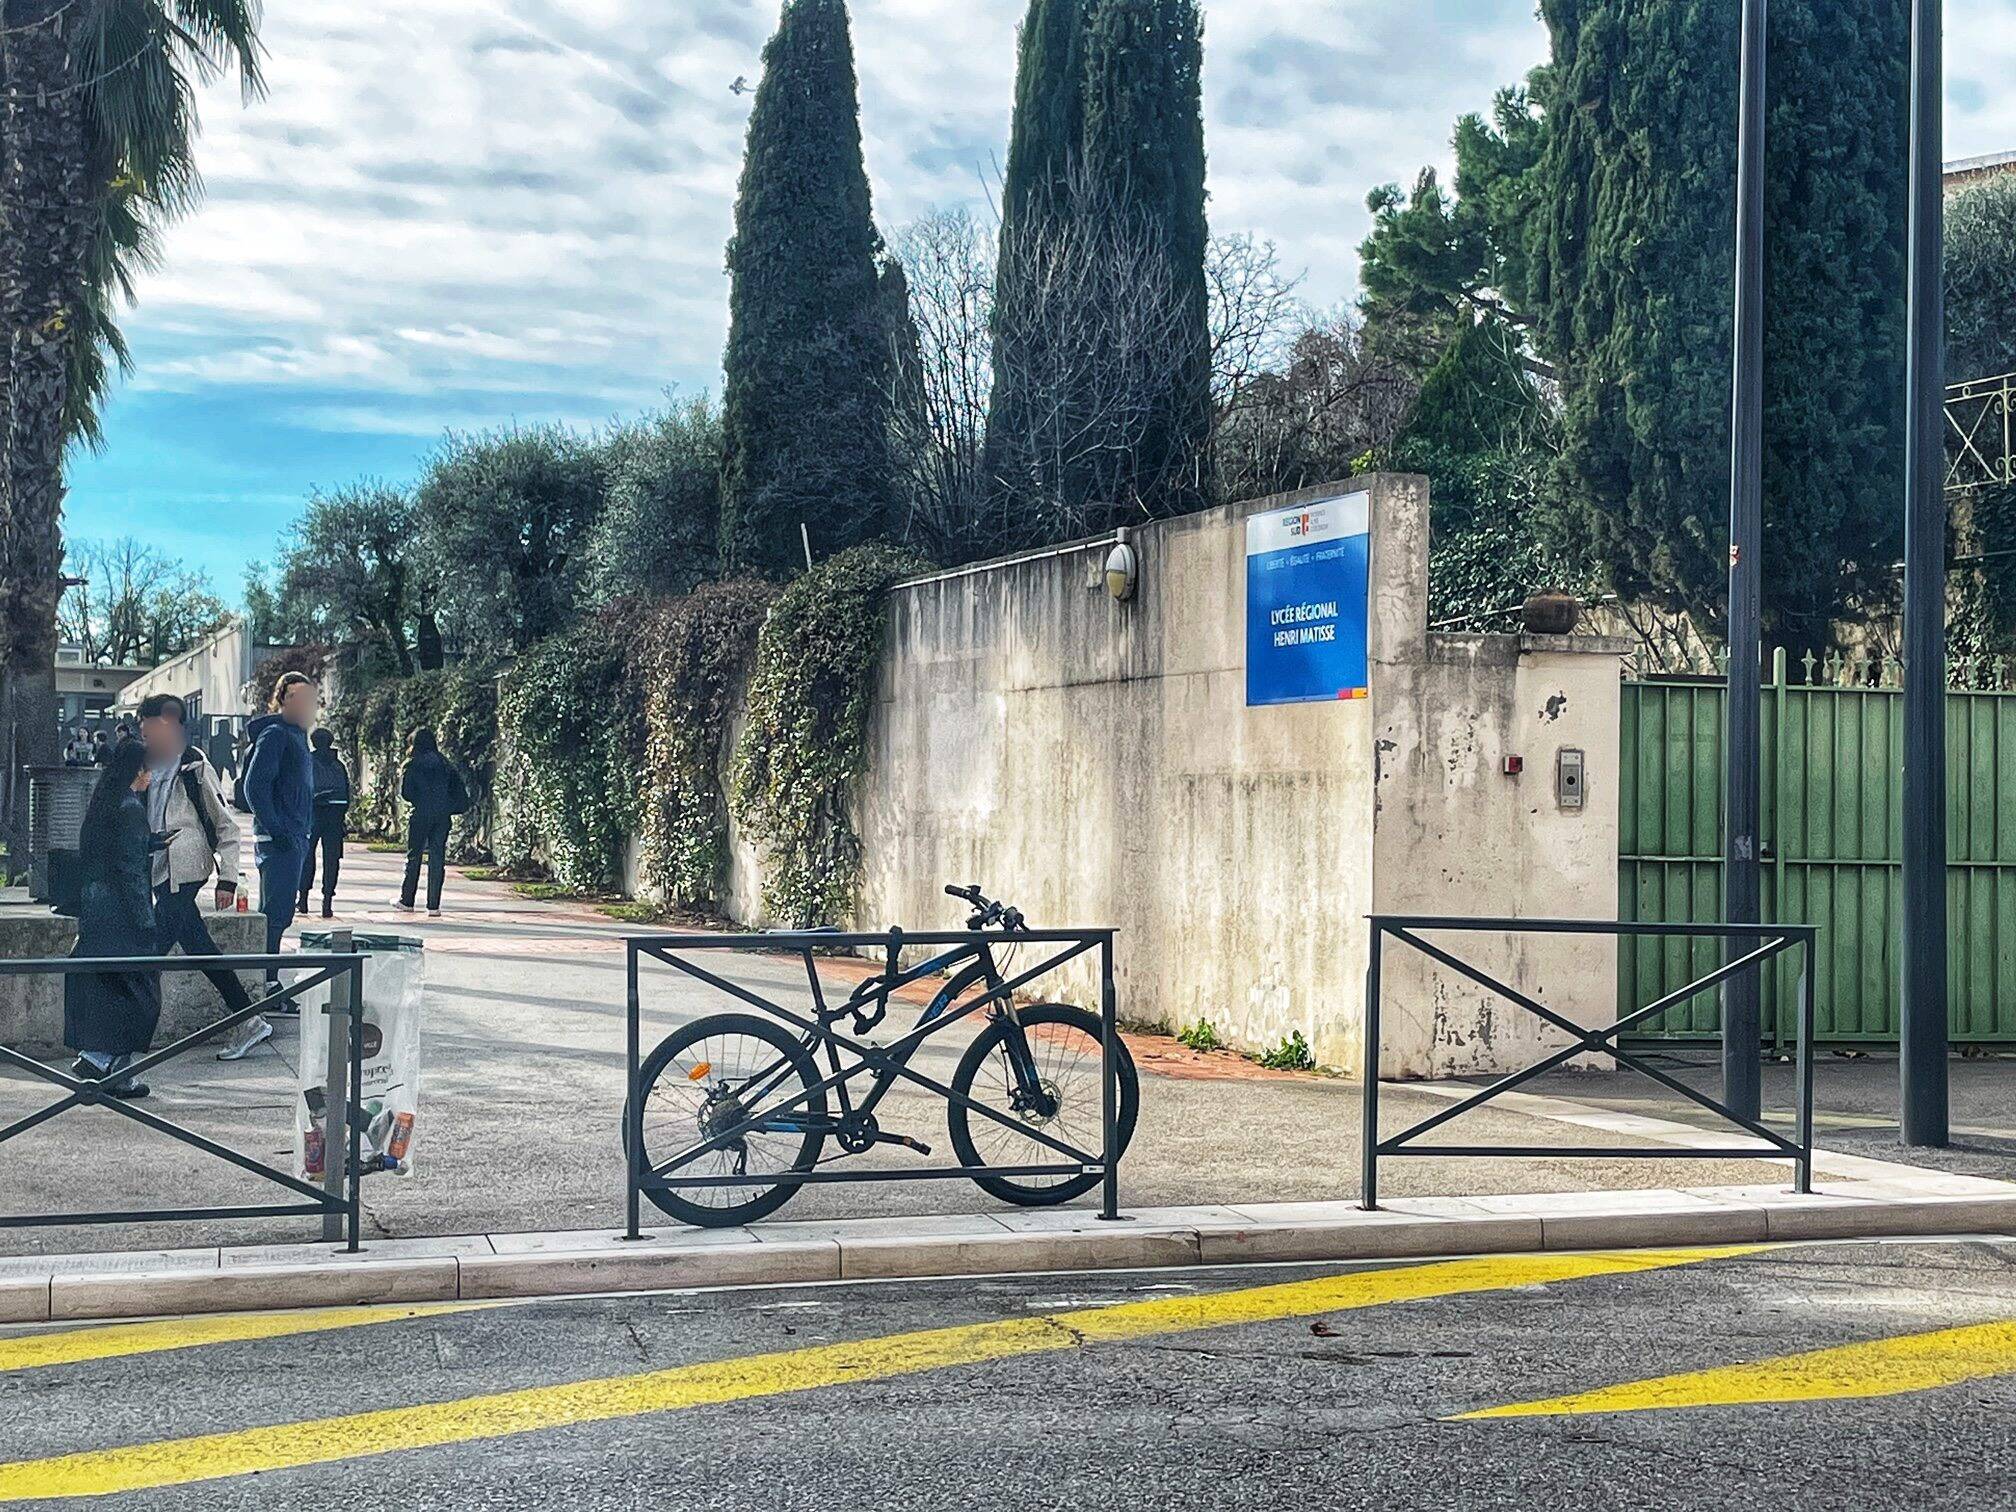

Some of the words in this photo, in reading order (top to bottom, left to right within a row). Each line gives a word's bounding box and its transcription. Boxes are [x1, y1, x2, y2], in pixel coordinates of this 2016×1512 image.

[1271, 604, 1295, 626] LYCÉE
[1295, 601, 1339, 622] RÉGIONAL
[1274, 629, 1299, 647] HENRI
[1300, 624, 1336, 644] MATISSE
